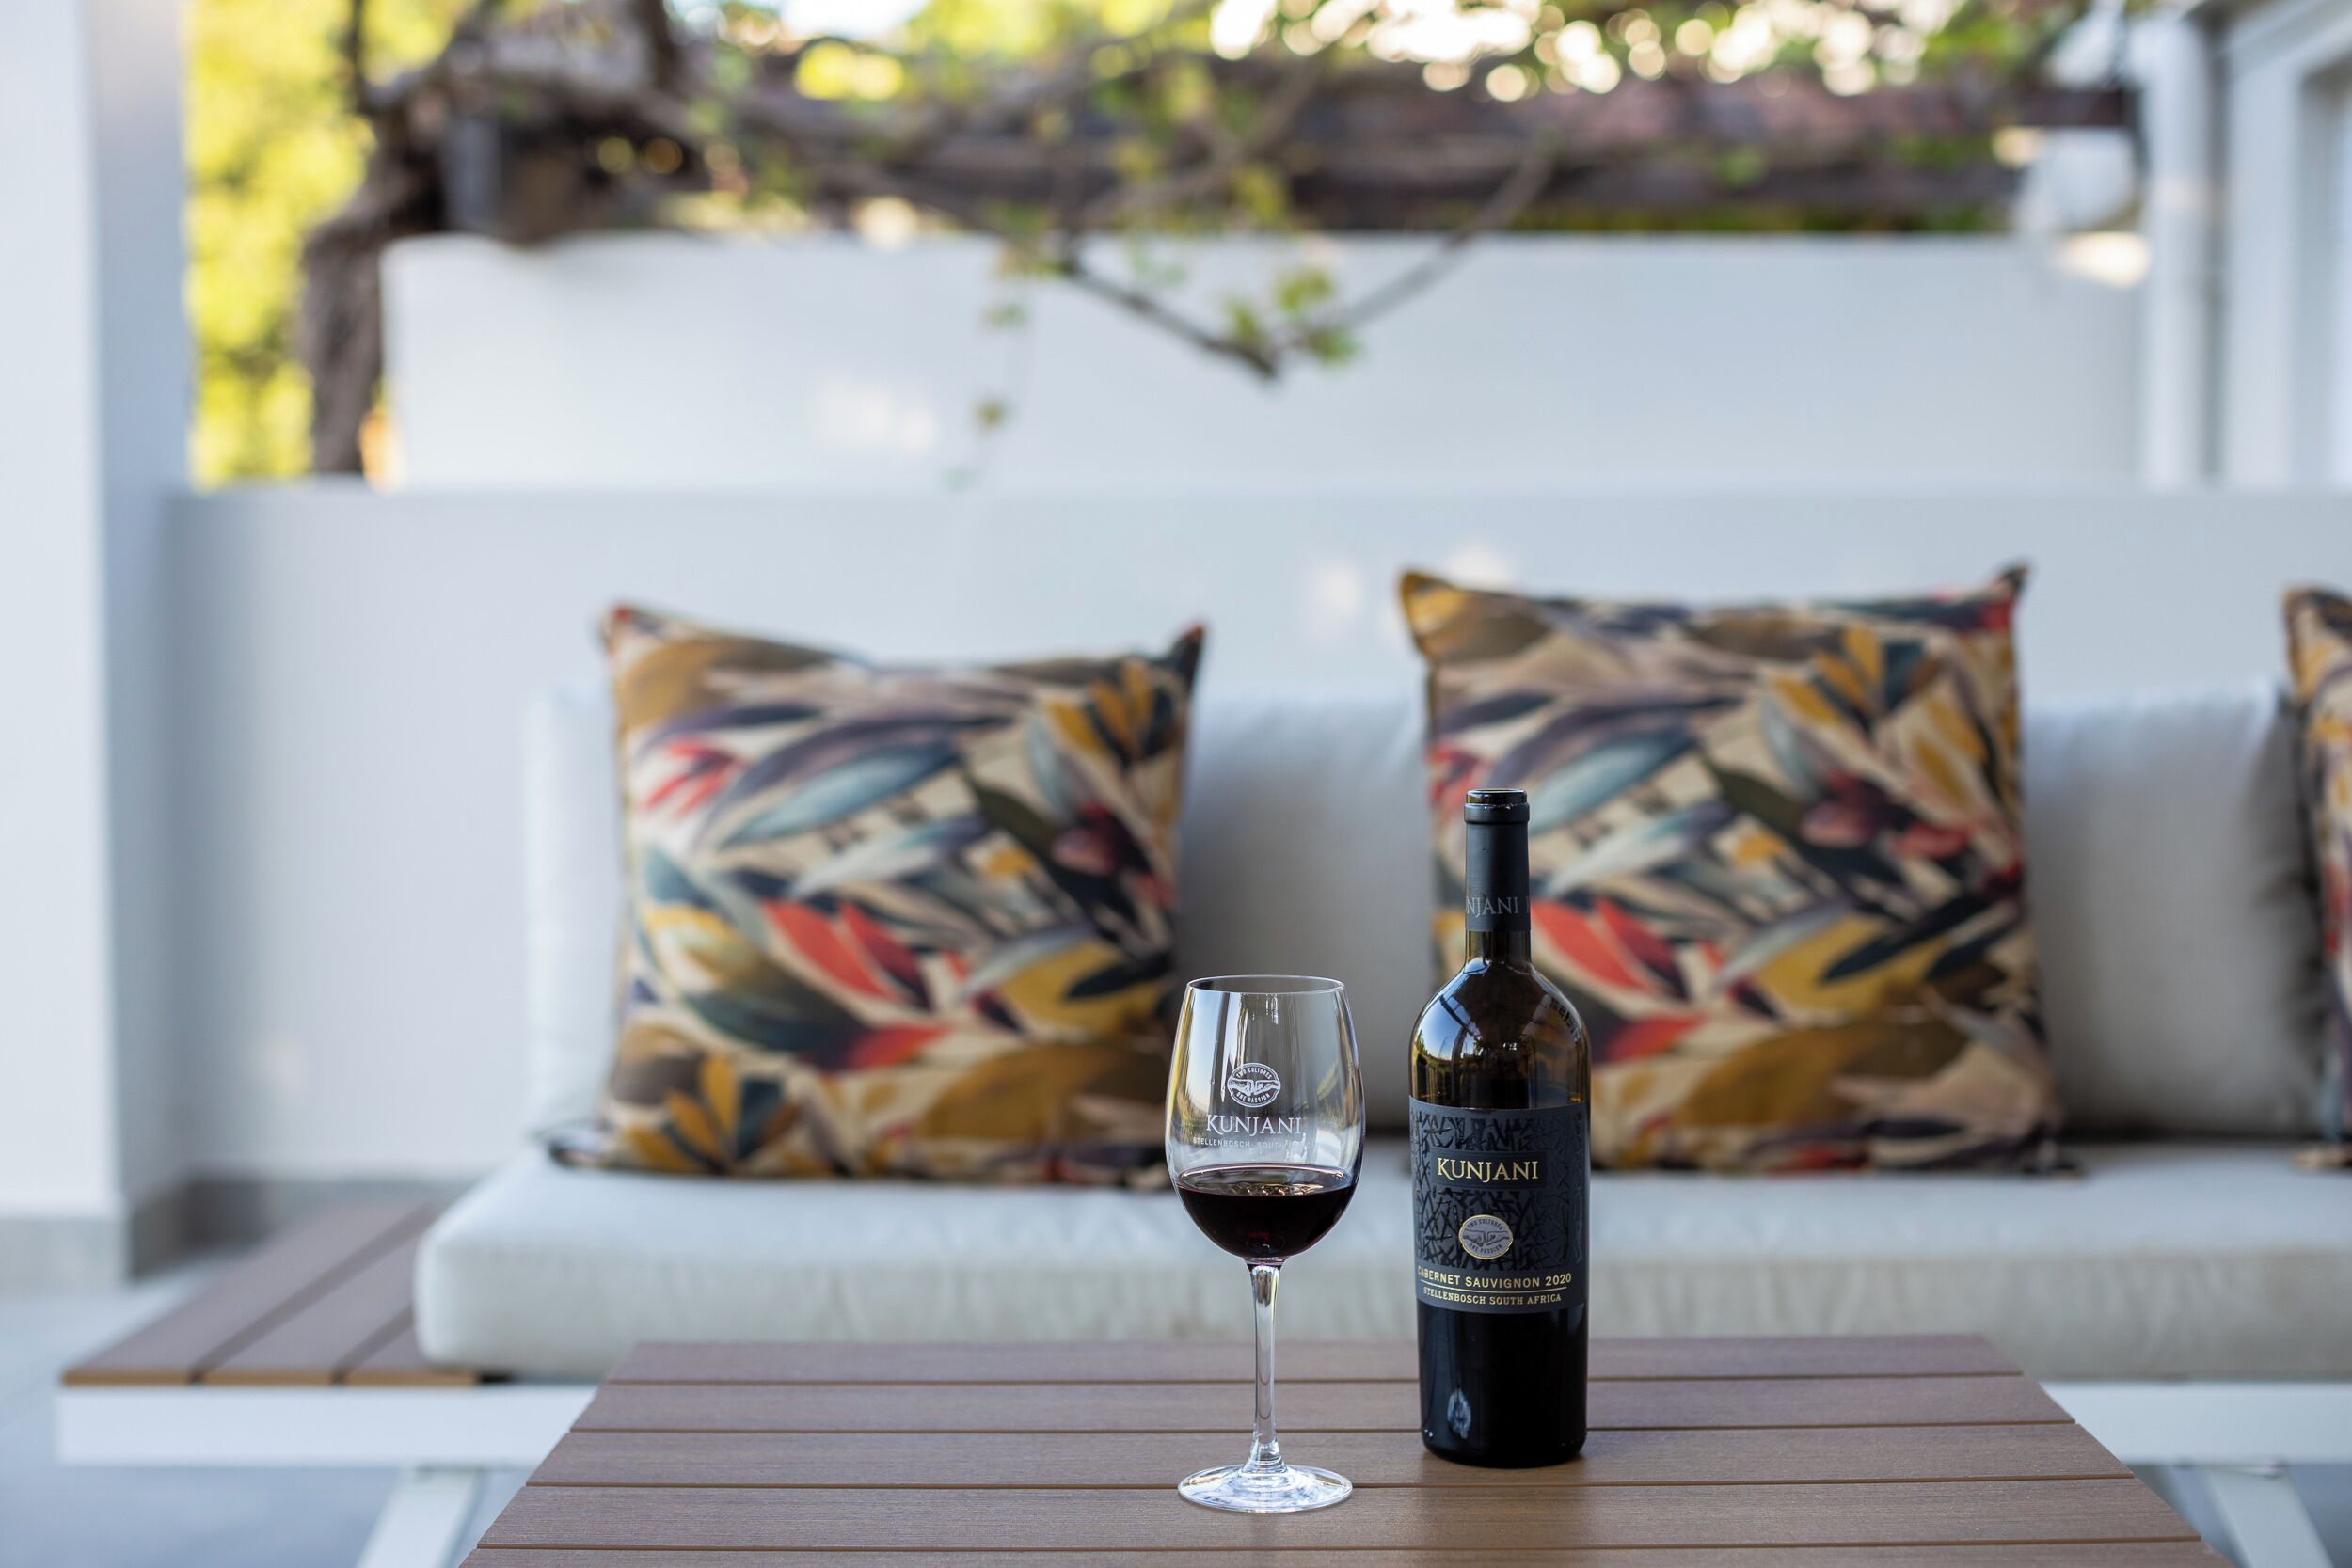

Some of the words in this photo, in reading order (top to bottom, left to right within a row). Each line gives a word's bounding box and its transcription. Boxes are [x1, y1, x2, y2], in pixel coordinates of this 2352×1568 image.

[1235, 1069, 1247, 1078] TWO
[1248, 1067, 1273, 1079] CULTURES
[1236, 1091, 1247, 1101] ONE
[1248, 1093, 1271, 1103] PASSION
[1206, 1114, 1301, 1136] KUNJANI
[1192, 1136, 1250, 1148] STELLENBOSCH
[1437, 1157, 1539, 1183] KUNJANI
[1479, 1218, 1504, 1230] CULTURES
[1480, 1243, 1502, 1255] PASSION
[1465, 1276, 1540, 1289] SAUVIGNON
[1545, 1273, 1572, 1286] 2020
[1422, 1286, 1486, 1305] STELLENBOSCH
[1489, 1296, 1523, 1306] SOUTH
[1527, 1293, 1562, 1305] AFRICA
